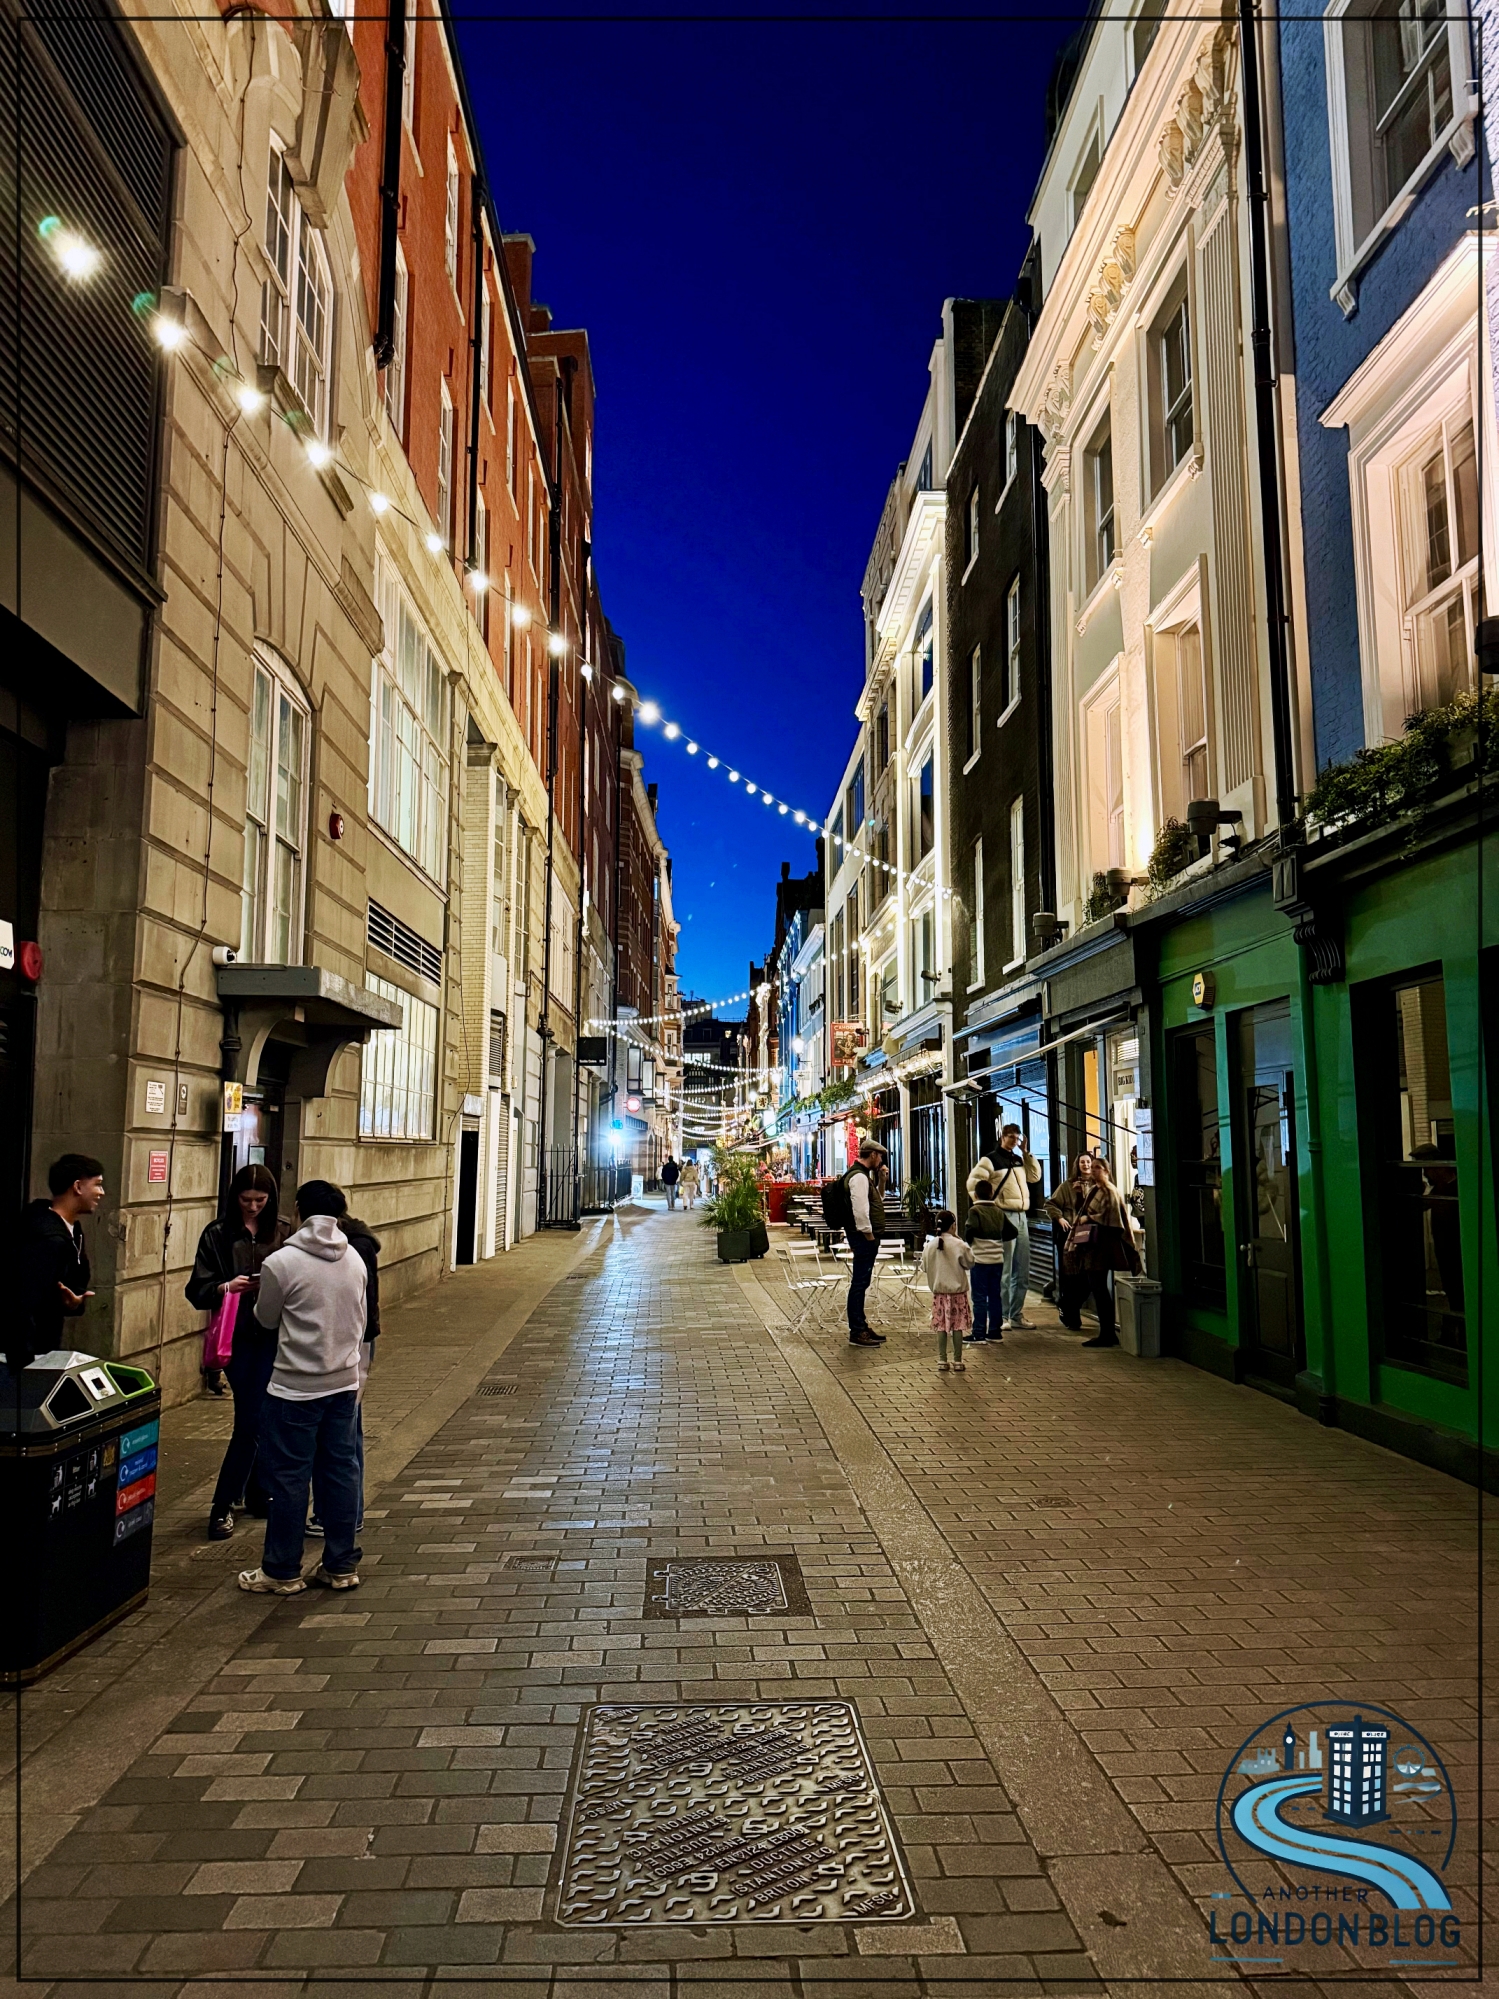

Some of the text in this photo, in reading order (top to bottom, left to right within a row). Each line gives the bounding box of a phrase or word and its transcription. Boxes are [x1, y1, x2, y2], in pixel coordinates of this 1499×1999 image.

[587, 1801, 625, 1818] MFSC
[657, 1808, 710, 1832] BRITON
[627, 1815, 728, 1857] STANTON PLC
[768, 1826, 805, 1845] E600
[645, 1836, 713, 1867] DUCTILE
[751, 1837, 816, 1870] DUCTILE
[654, 1857, 693, 1876] E600
[734, 1845, 833, 1895] STANTON PLC
[852, 1890, 893, 1914] MFSC
